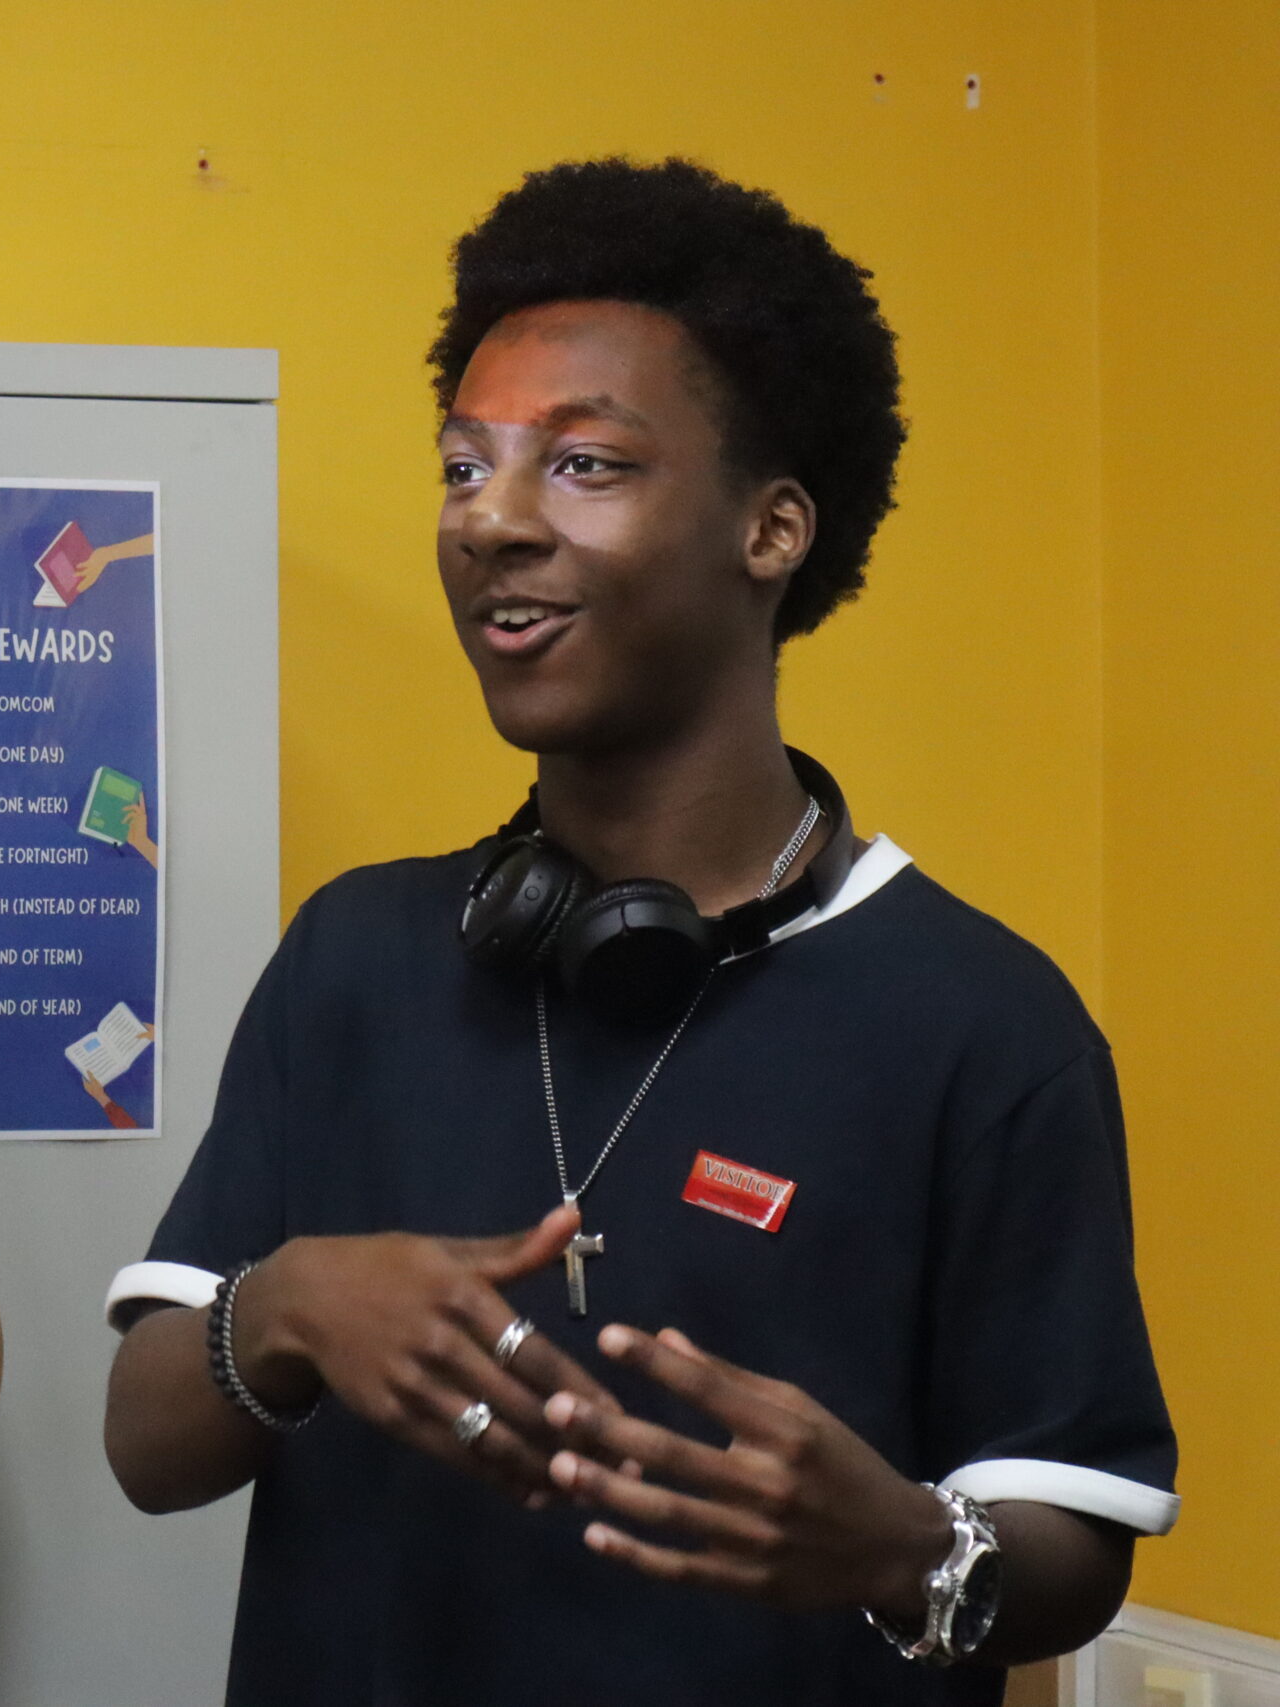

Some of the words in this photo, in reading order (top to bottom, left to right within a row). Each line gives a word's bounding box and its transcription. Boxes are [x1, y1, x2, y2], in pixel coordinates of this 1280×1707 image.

[30, 746, 65, 765] DAY)
[28, 797, 69, 815] WEEK)
[8, 848, 89, 865] FORTNIGHT)
[13, 898, 75, 916] (INSTEAD
[78, 898, 97, 915] OF
[100, 898, 141, 916] DEAR)
[21, 949, 40, 966] OF
[42, 949, 84, 967] TERM)
[20, 1000, 38, 1017] OF
[42, 1000, 83, 1018] YEAR)
